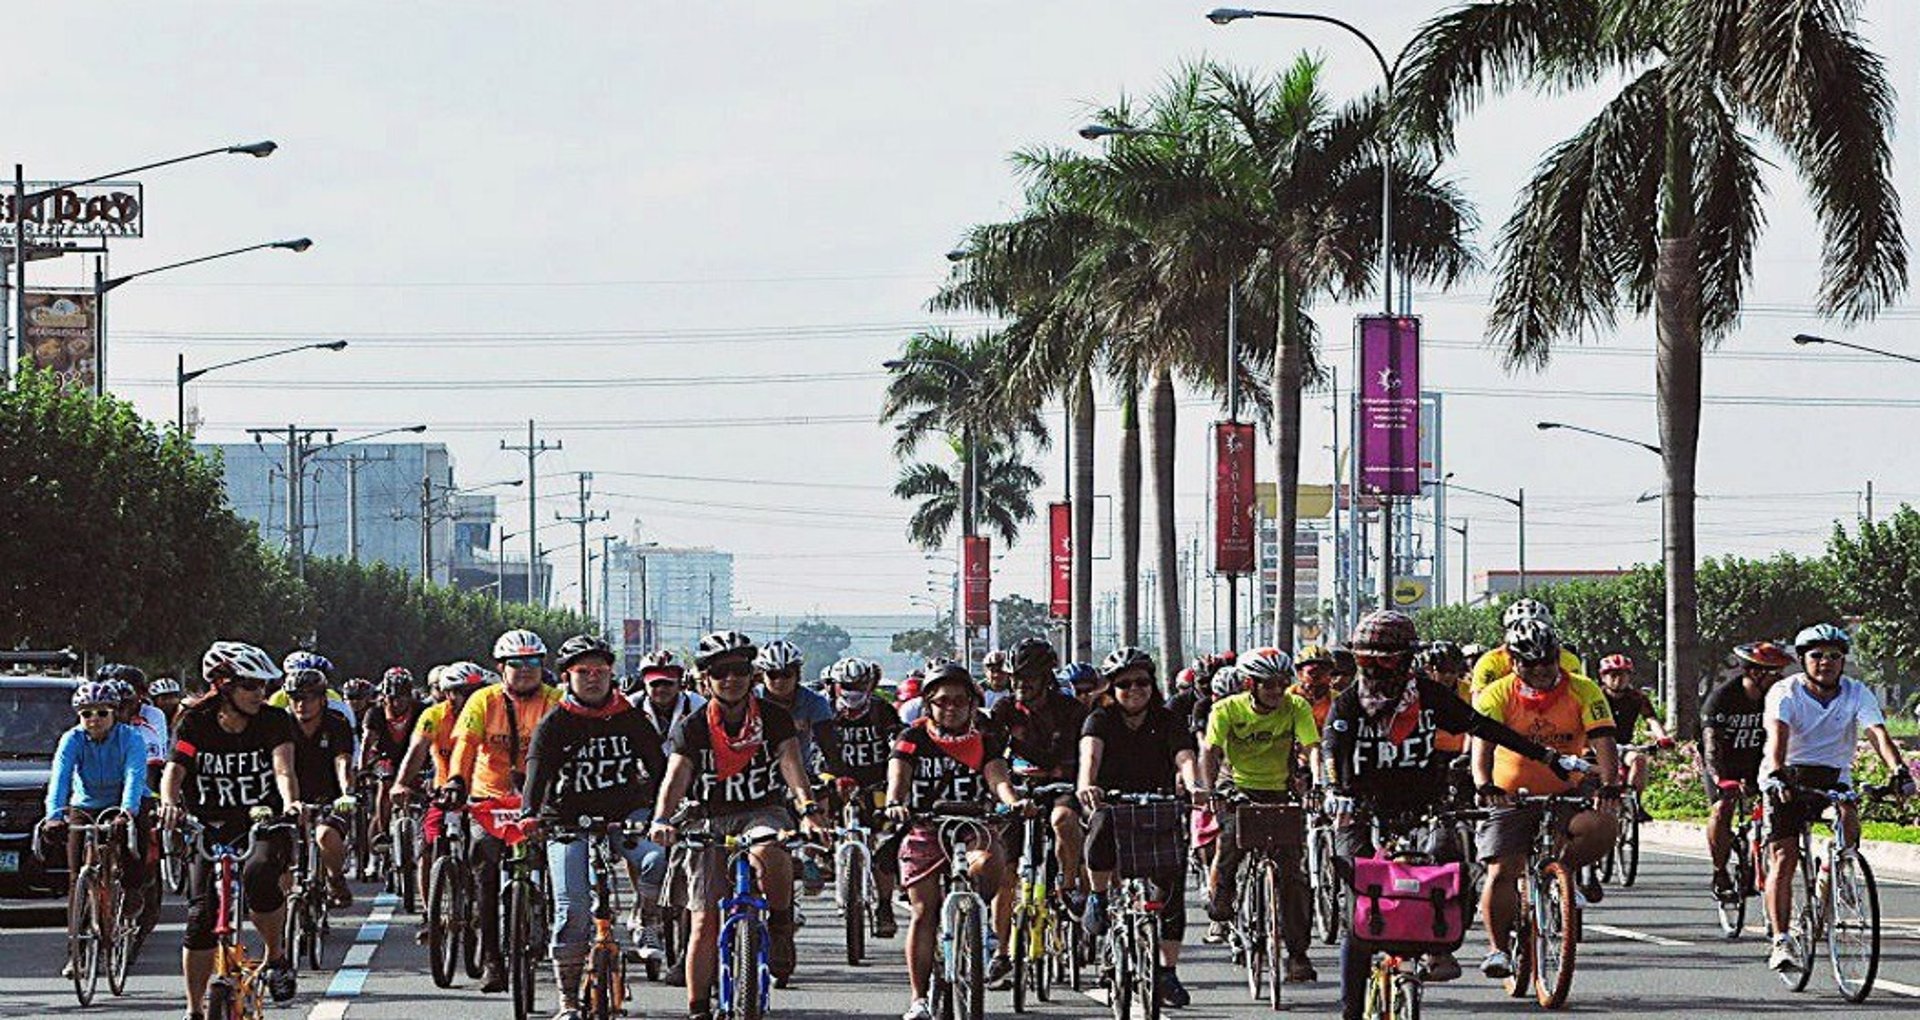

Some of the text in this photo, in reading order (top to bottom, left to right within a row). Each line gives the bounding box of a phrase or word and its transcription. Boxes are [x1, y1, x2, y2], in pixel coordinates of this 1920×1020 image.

[1231, 460, 1240, 537] SOLAIRE
[196, 748, 270, 774] TRAFFIC
[836, 740, 885, 767] REE
[197, 769, 273, 807] FREE
[702, 759, 780, 802] FREE
